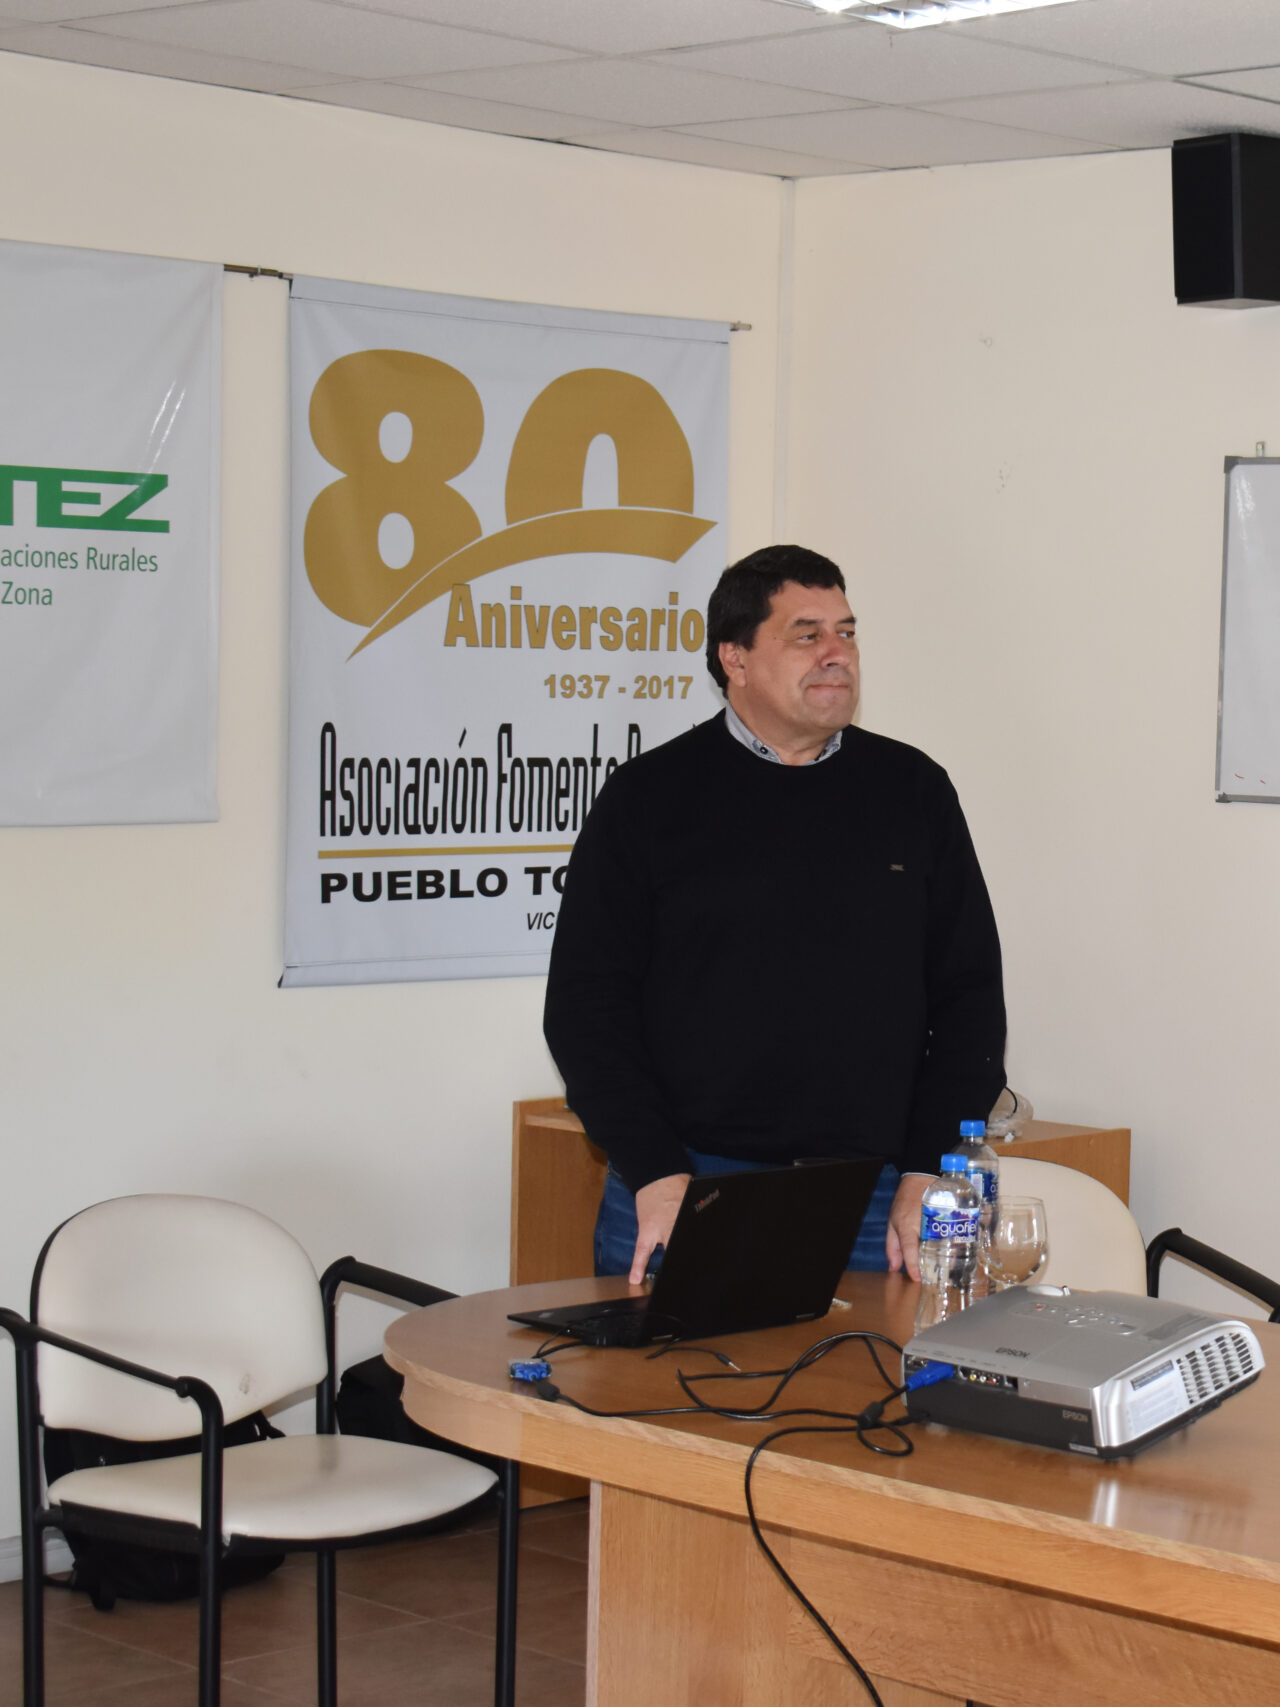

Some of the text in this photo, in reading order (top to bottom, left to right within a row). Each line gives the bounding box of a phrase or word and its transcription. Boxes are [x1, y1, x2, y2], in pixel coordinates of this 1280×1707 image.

[303, 348, 696, 627] 80
[86, 546, 159, 572] Rurales
[0, 580, 53, 606] Zona
[443, 583, 706, 653] Aniversario
[544, 674, 611, 699] 1937
[632, 675, 694, 699] 2017
[319, 721, 618, 837] Asociación Foment
[320, 867, 508, 904] PUEBLO
[526, 911, 557, 931] VIC
[931, 1221, 978, 1237] aguafiel
[995, 1346, 1031, 1359] EPSON
[1062, 1409, 1089, 1422] EPSON
